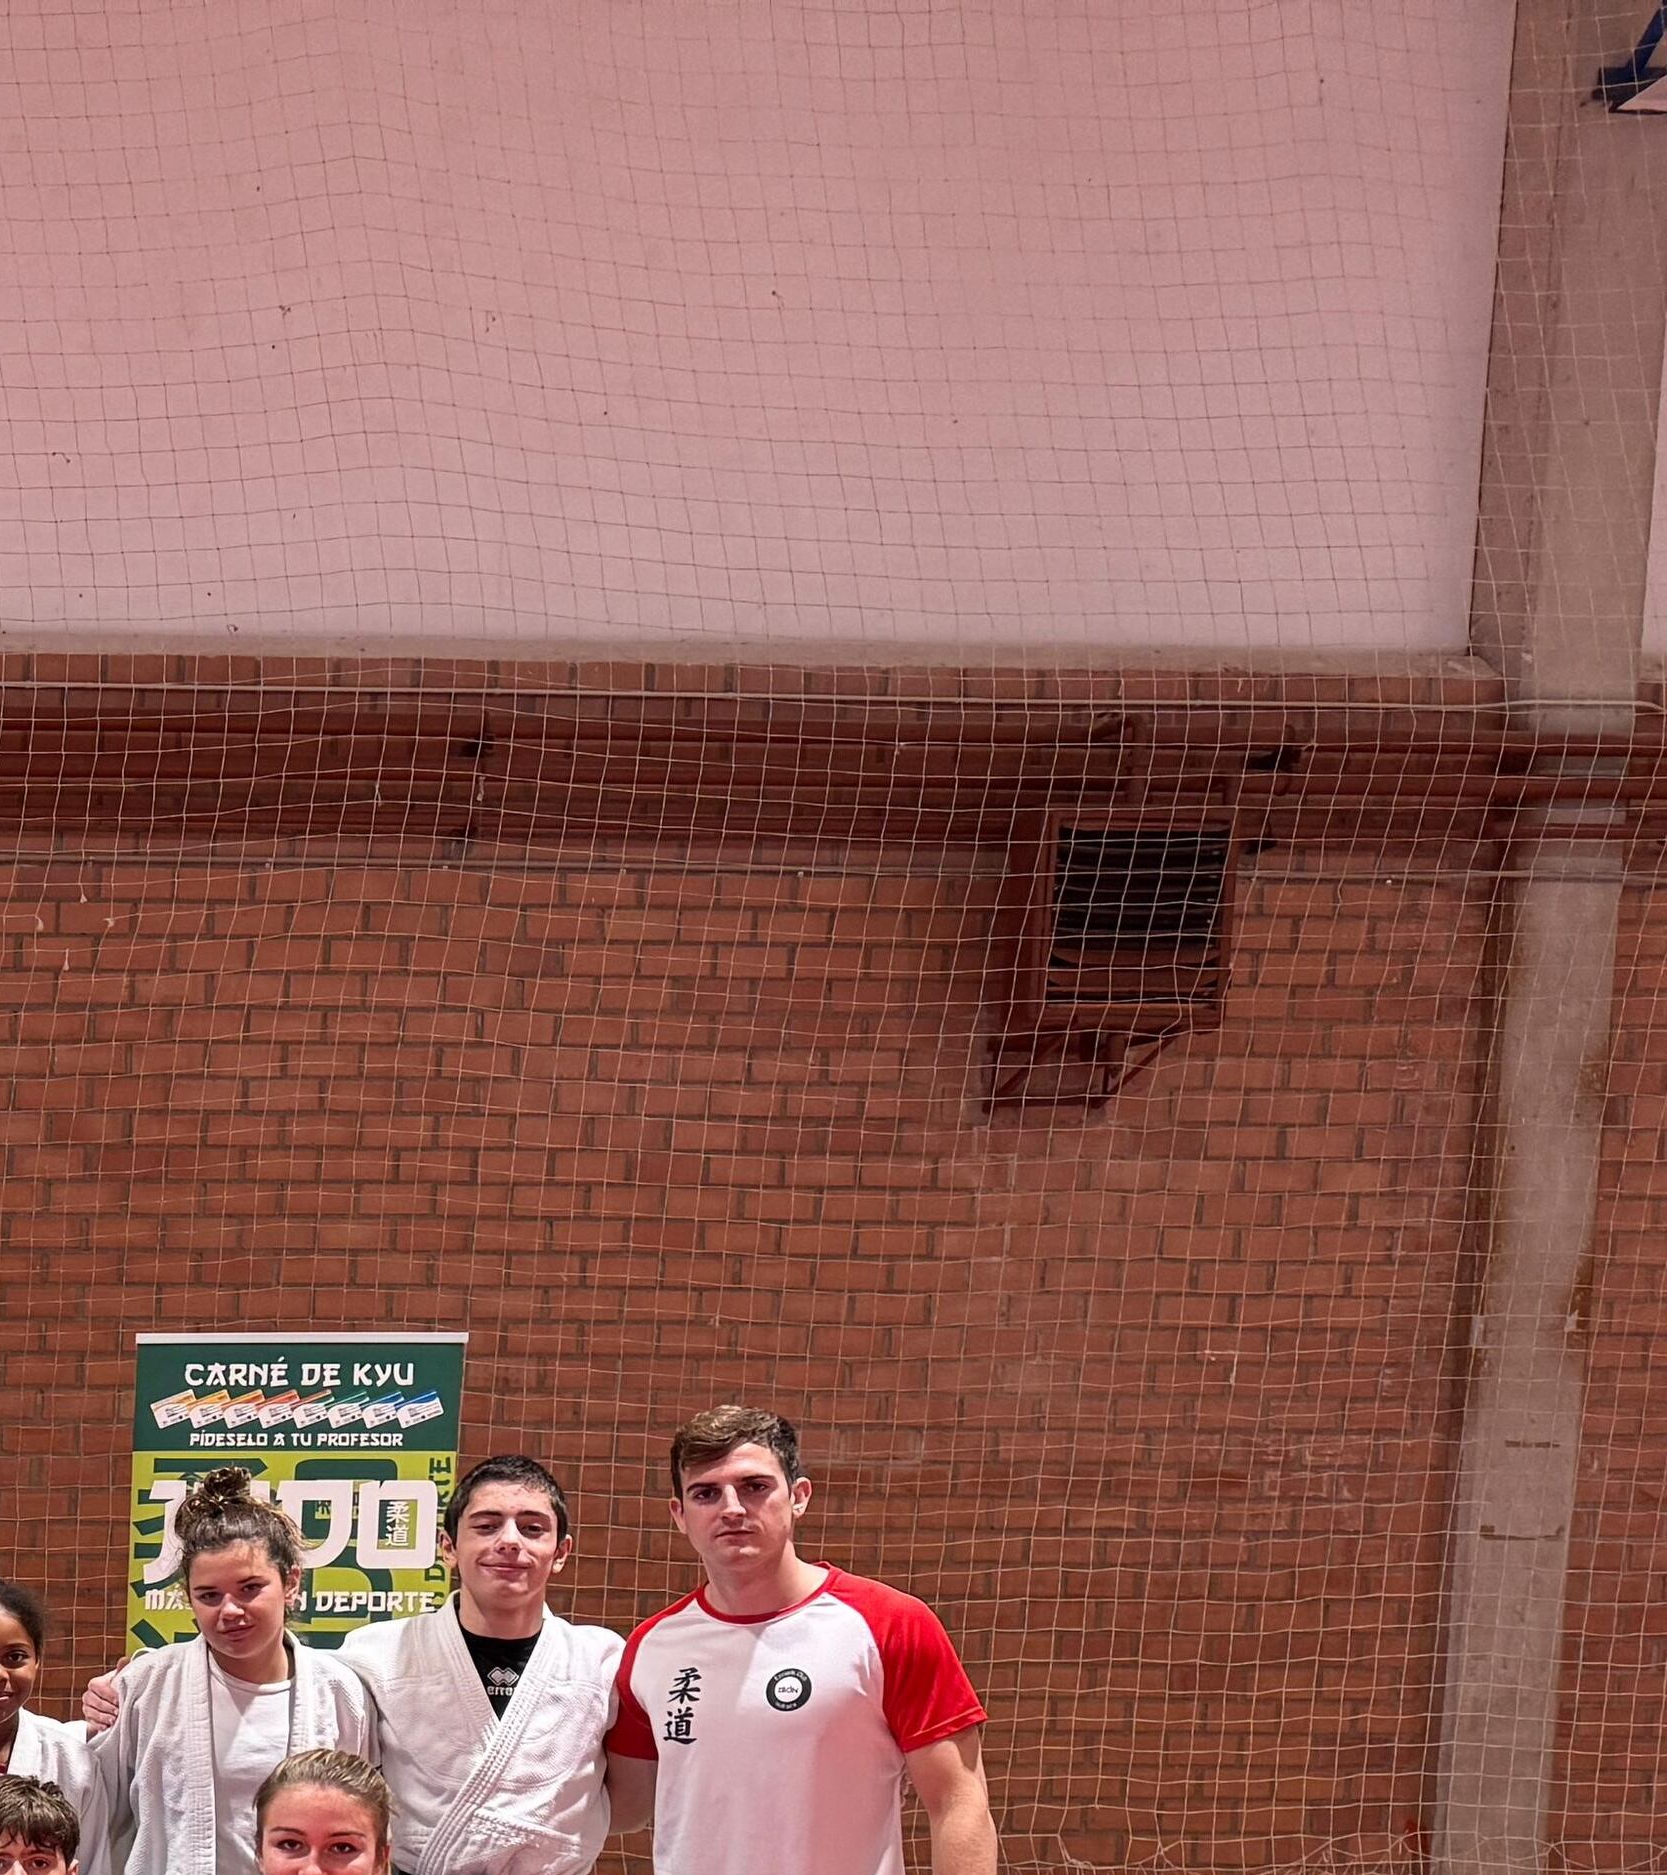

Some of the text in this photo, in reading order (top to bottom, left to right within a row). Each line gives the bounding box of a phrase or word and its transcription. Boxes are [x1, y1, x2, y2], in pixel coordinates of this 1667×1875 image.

[184, 1356, 415, 1388] CARNÉ DE KYU
[189, 1429, 404, 1447] PÍDESELO A TU PROFESOR
[385, 1500, 411, 1547] 柔道
[315, 1590, 436, 1612] DEPORTE
[663, 1666, 702, 1745] 柔道
